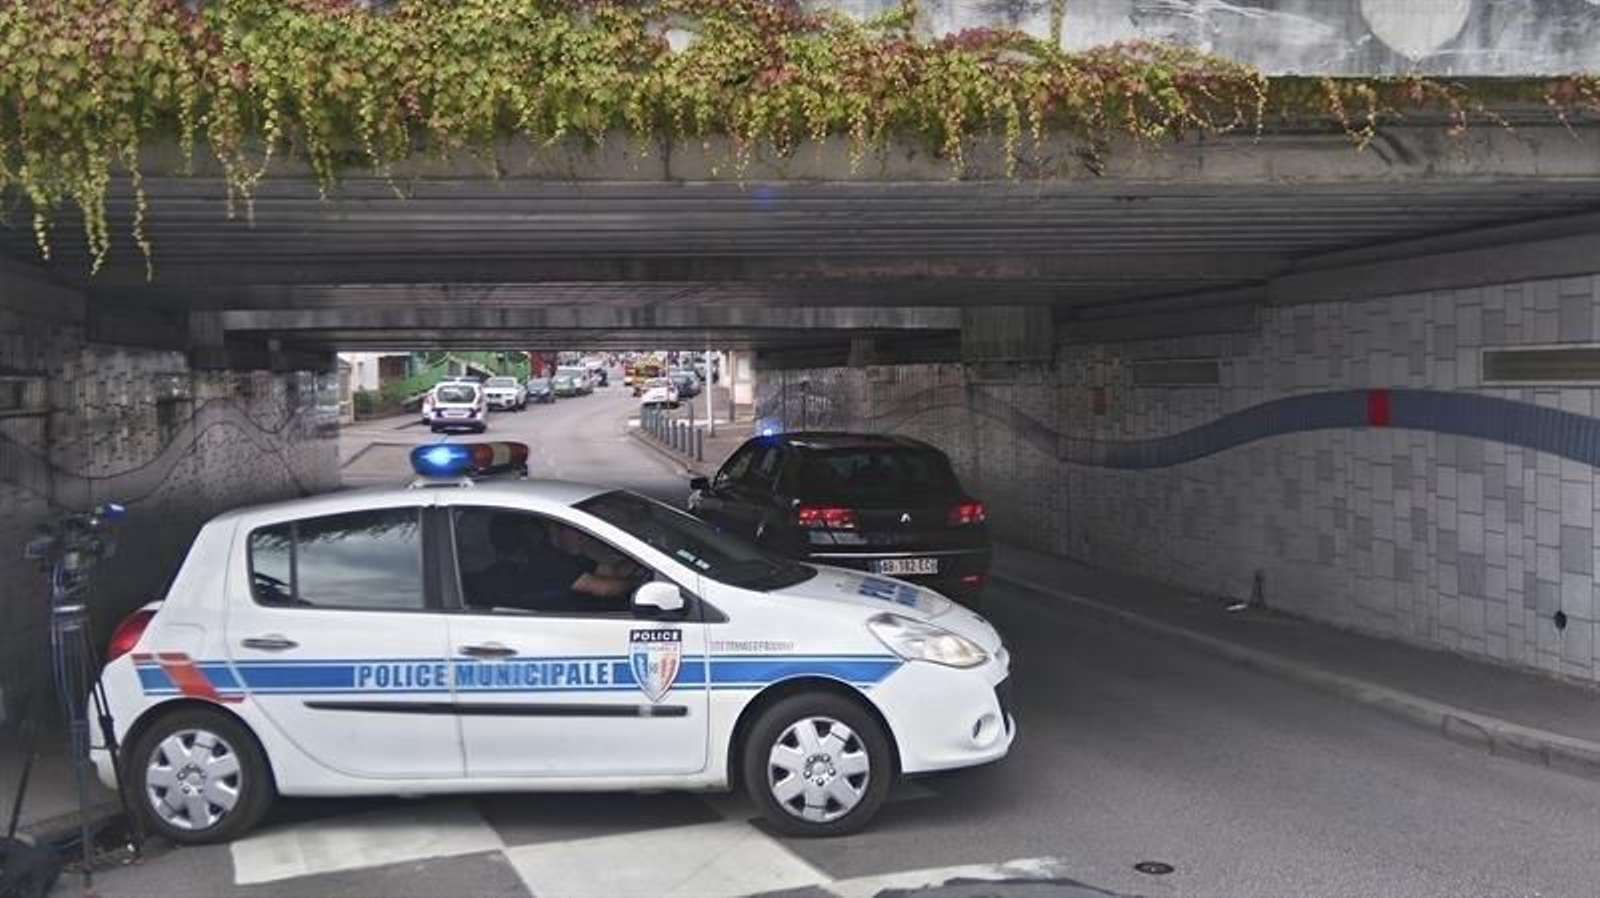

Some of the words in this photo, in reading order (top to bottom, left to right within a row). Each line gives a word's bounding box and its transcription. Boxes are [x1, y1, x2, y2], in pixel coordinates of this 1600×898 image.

[632, 631, 679, 641] POLICE
[358, 664, 445, 687] POLICE
[455, 662, 609, 686] MUNICIPALE
